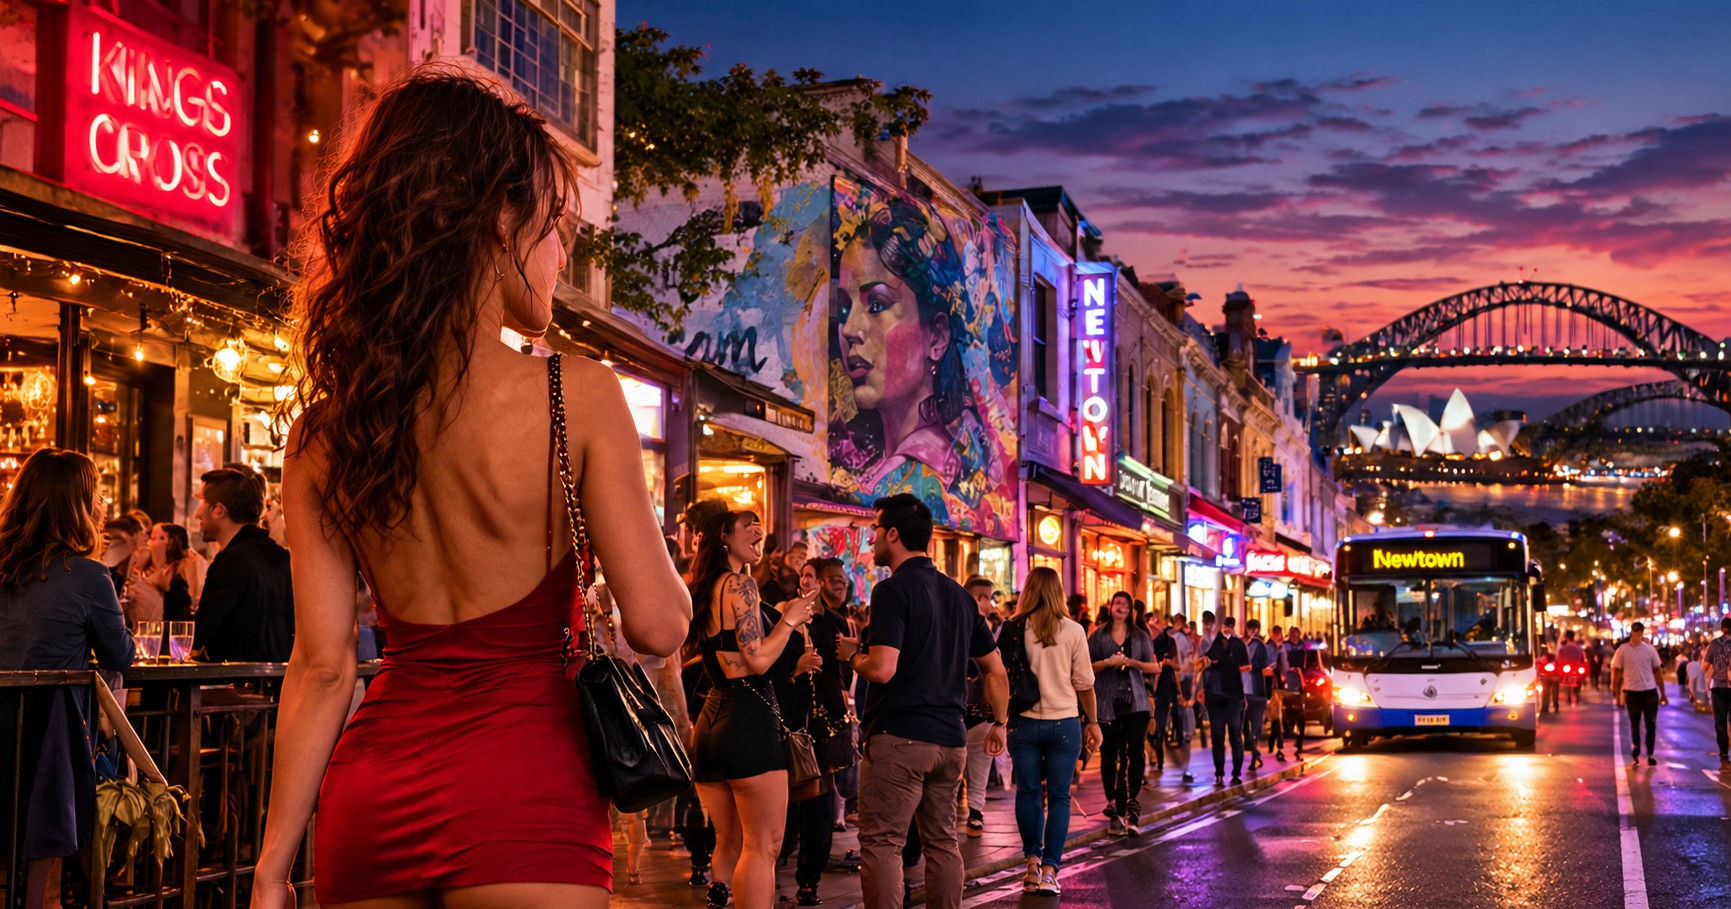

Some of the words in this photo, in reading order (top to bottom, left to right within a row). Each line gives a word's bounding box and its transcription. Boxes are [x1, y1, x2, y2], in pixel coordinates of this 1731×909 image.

[91, 32, 231, 137] KINGS
[89, 113, 231, 207] CROSS
[1082, 278, 1108, 480] NEWTOWN
[1373, 549, 1464, 568] Newtown
